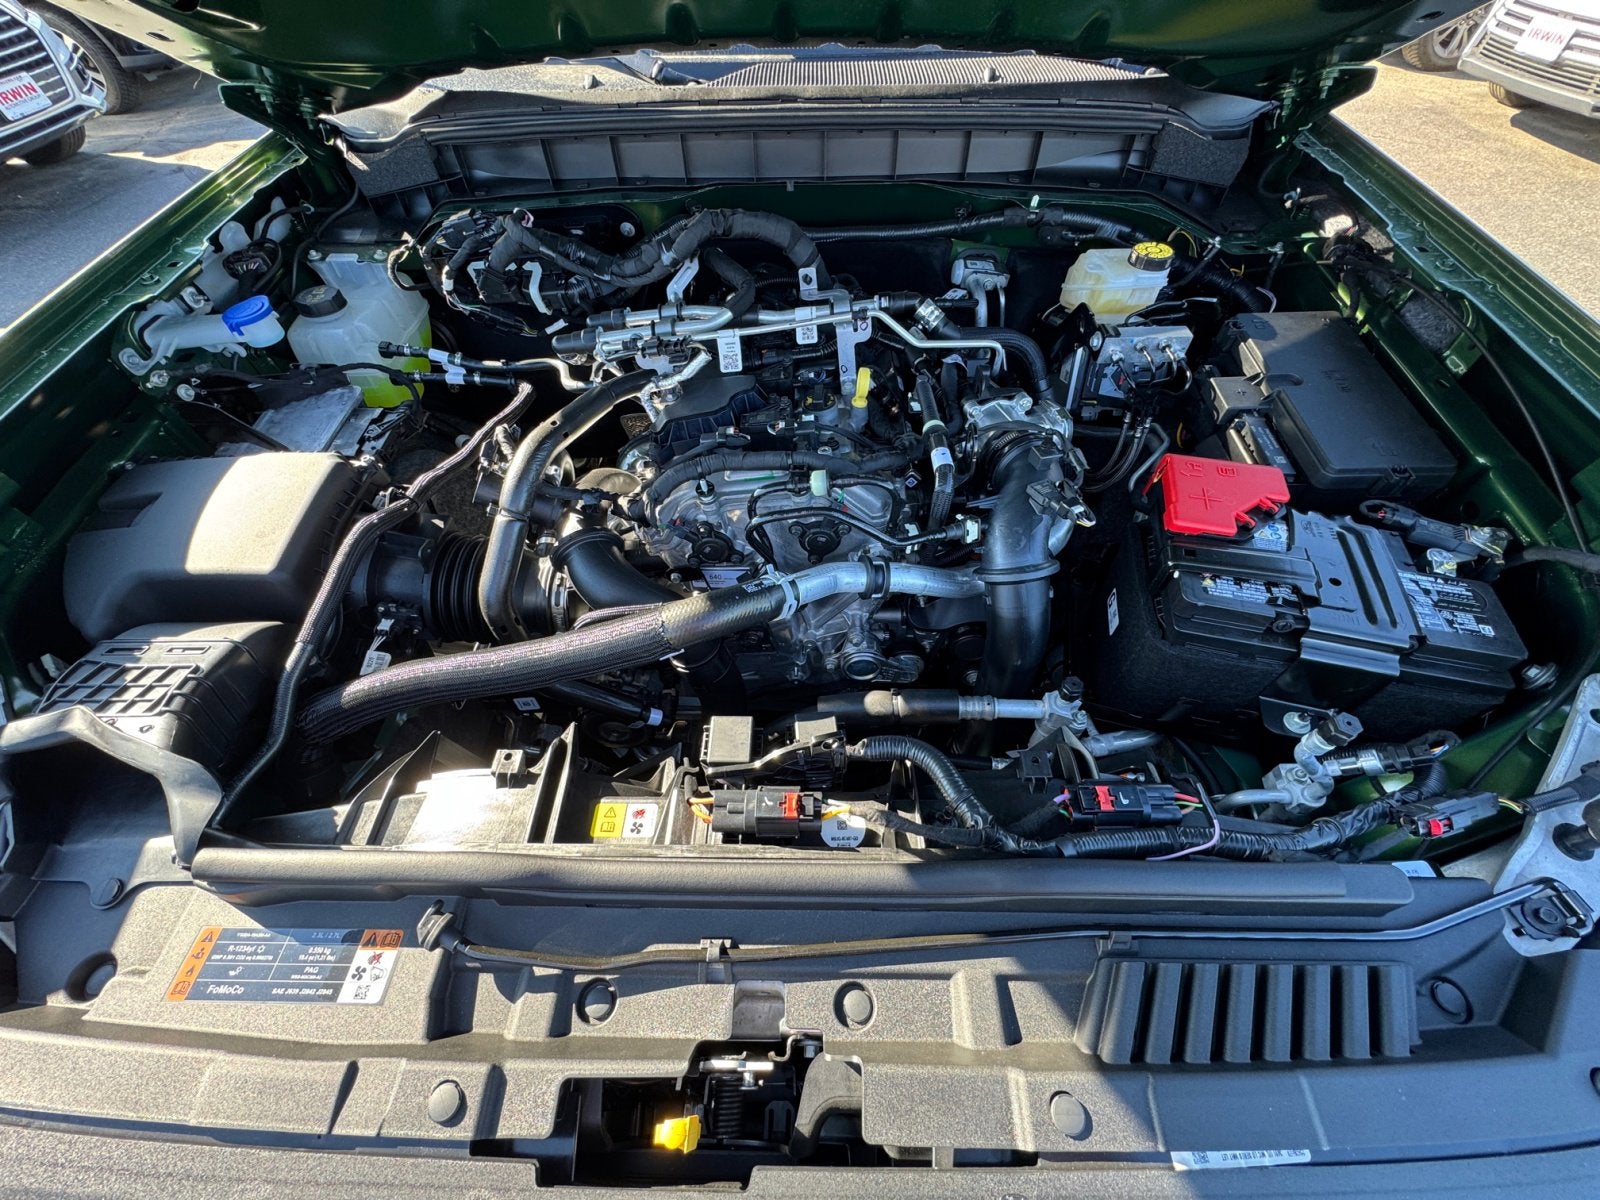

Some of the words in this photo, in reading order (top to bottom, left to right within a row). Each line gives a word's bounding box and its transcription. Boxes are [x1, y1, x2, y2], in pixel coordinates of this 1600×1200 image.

[1528, 27, 1565, 45] IRWIN
[227, 944, 257, 954] R-1234yf
[206, 984, 245, 994] FoMoCo
